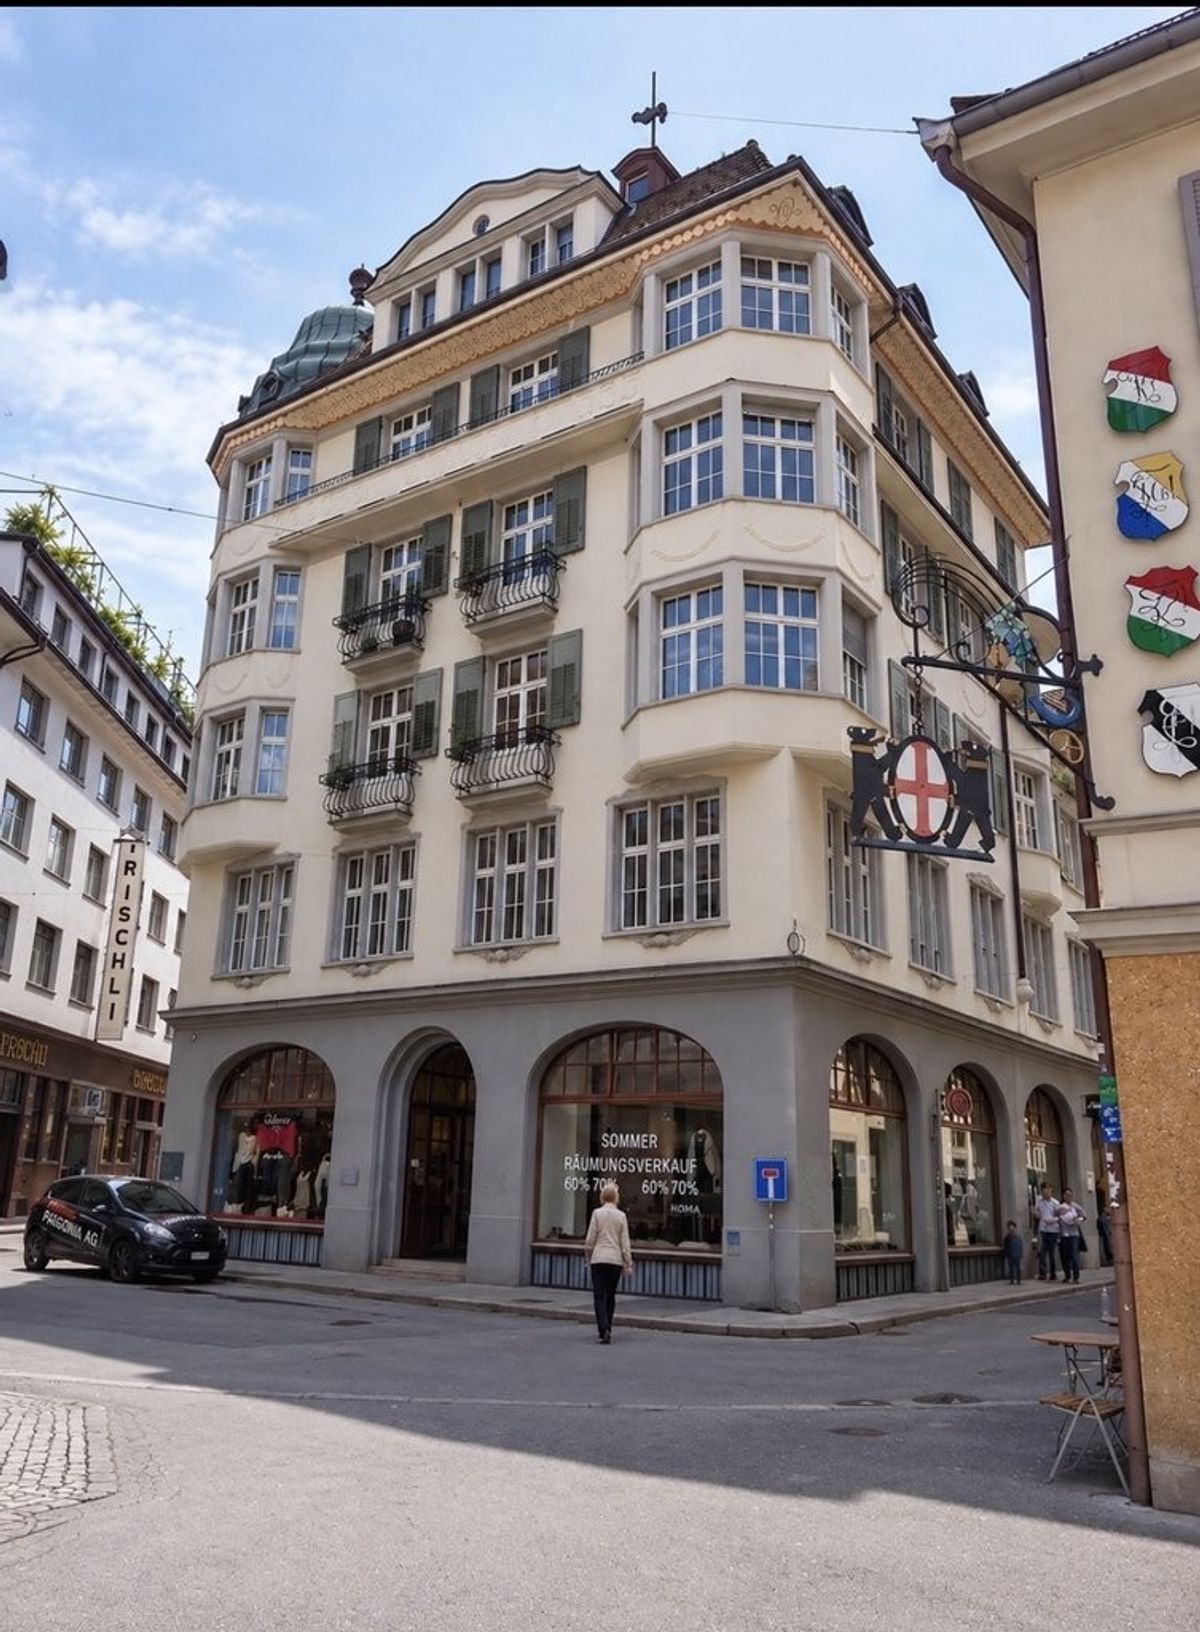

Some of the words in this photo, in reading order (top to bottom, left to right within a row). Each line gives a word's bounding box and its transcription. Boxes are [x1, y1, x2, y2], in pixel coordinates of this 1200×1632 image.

[601, 1132, 658, 1149] SOMMER
[564, 1153, 698, 1175] RÄUMUNGSVERKAUF
[564, 1176, 591, 1191] 60%
[641, 1179, 669, 1195] 60%
[671, 1180, 699, 1196] 70%
[83, 1230, 98, 1247] AG
